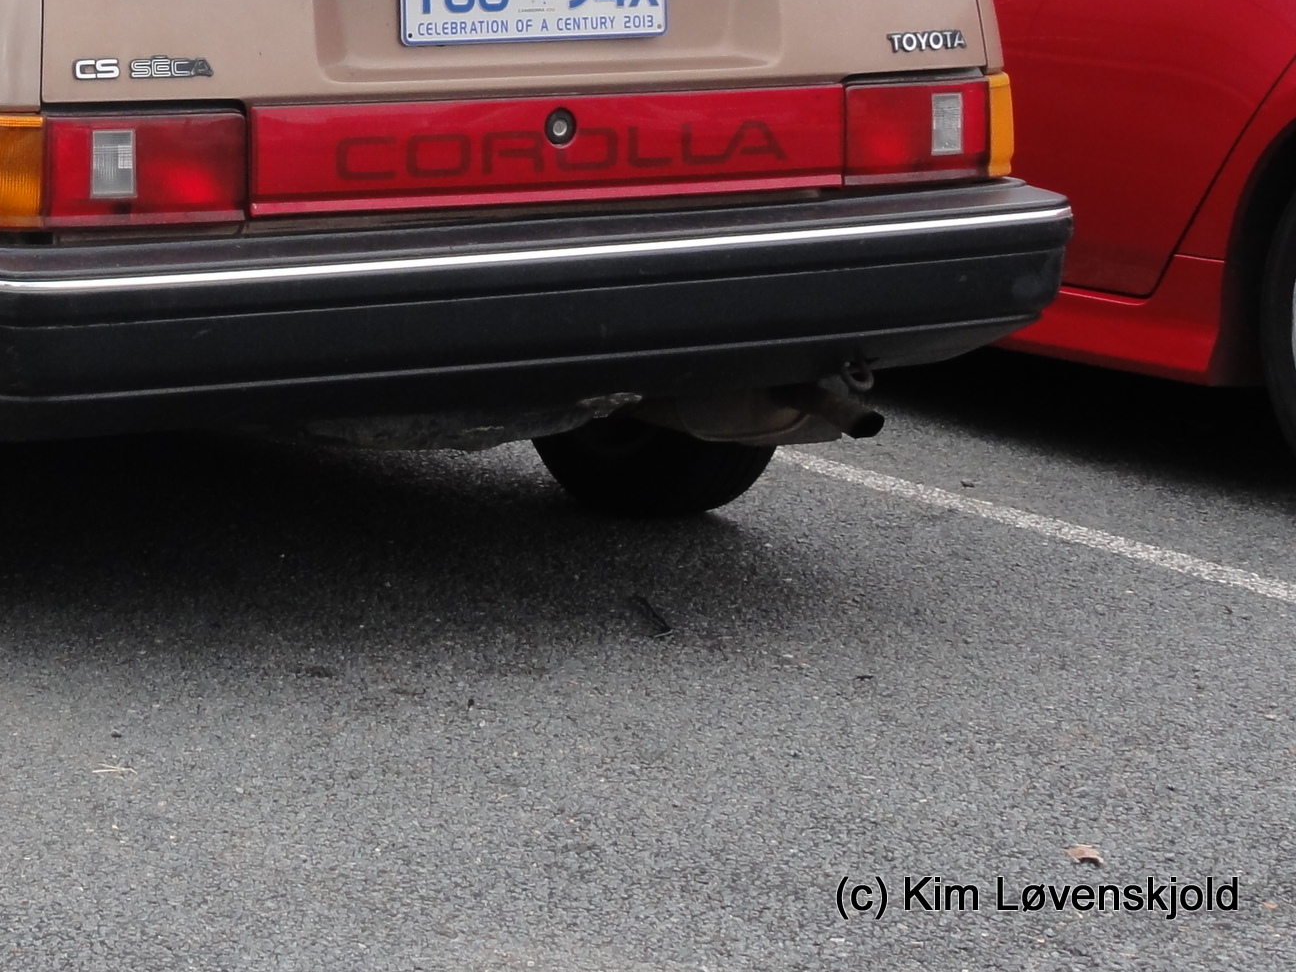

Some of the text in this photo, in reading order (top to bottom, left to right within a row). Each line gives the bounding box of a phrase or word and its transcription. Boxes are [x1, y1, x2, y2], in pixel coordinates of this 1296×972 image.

[417, 14, 655, 37] CELEBRATION OF A CENTURY 2013
[887, 29, 967, 53] TOYOTA
[74, 57, 121, 80] CS
[336, 119, 787, 182] COROLLA
